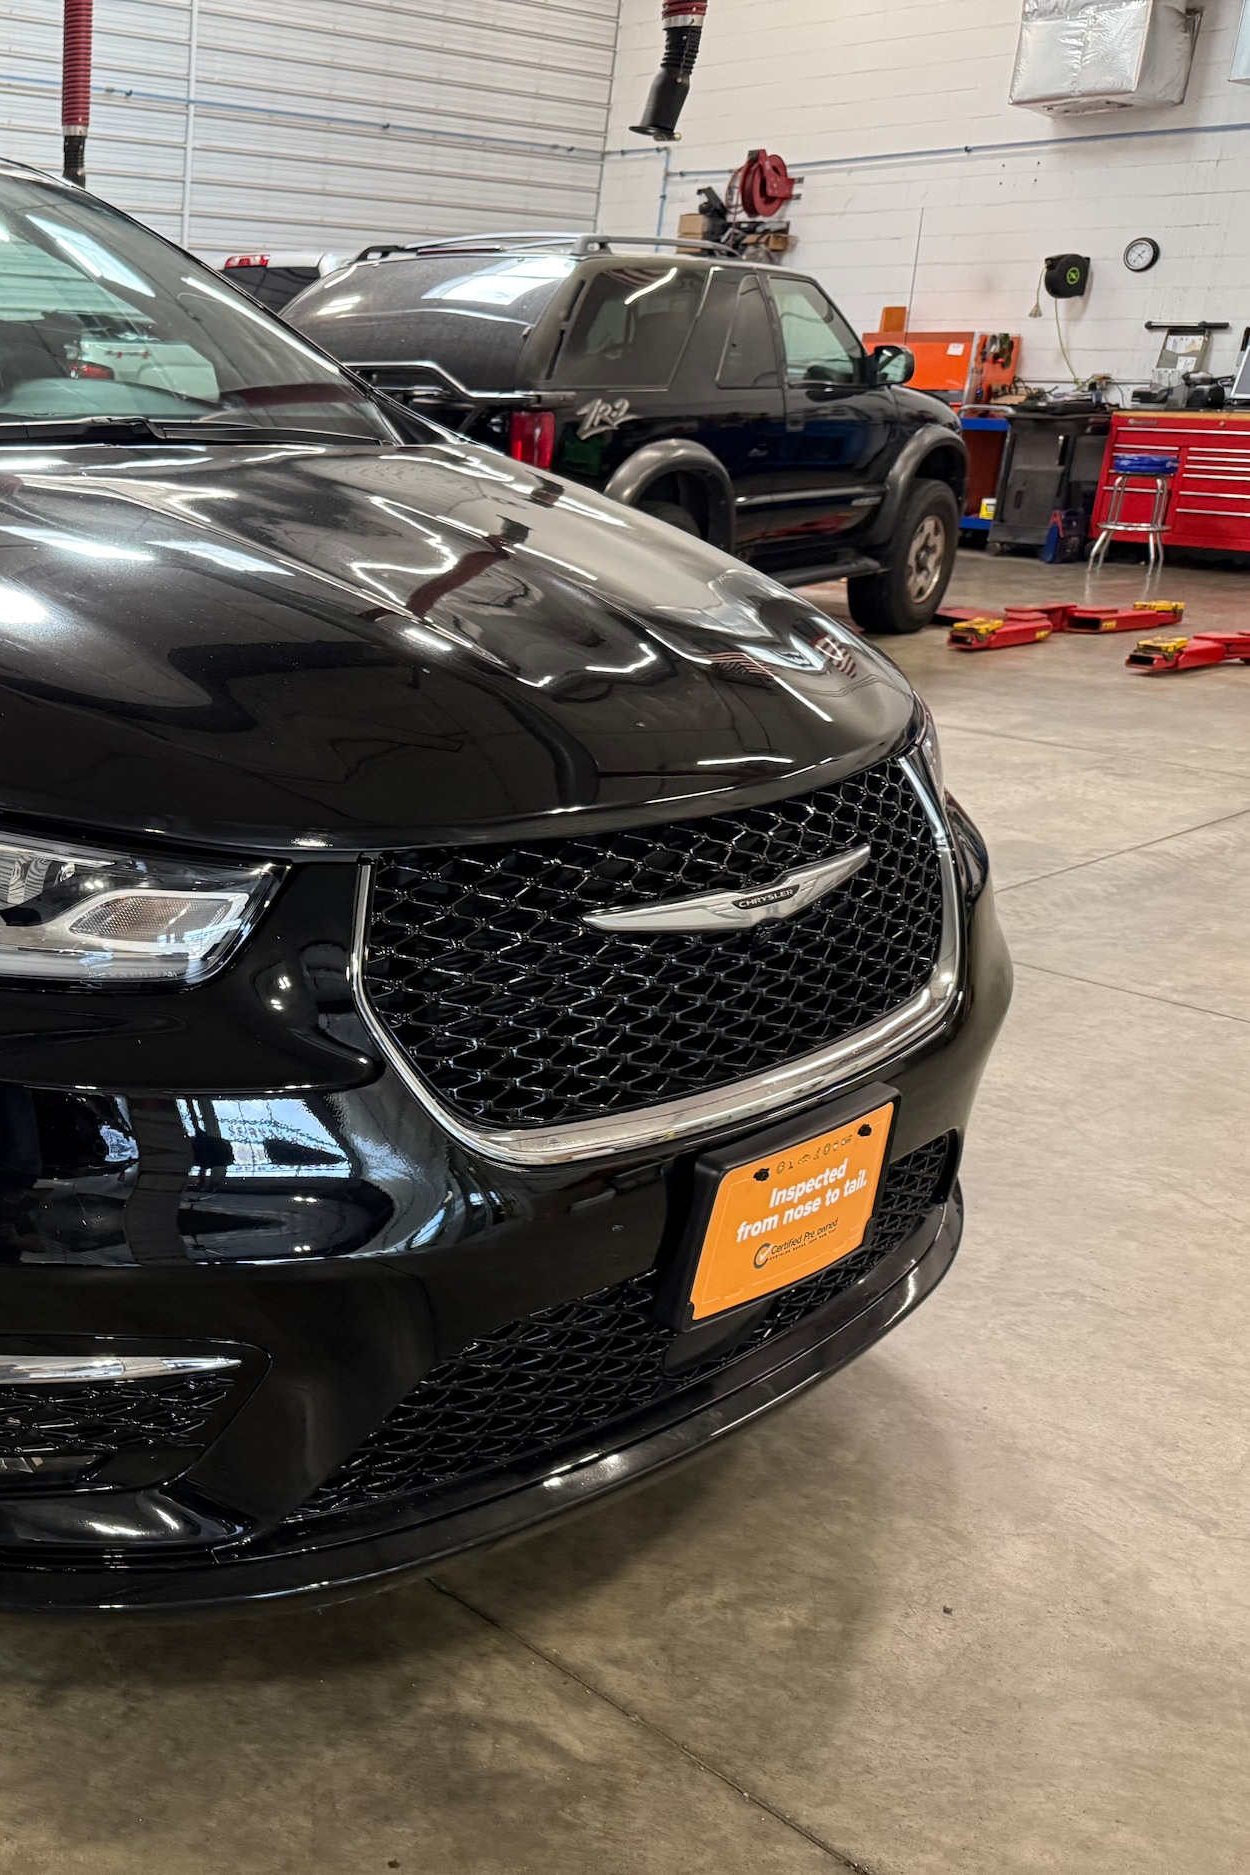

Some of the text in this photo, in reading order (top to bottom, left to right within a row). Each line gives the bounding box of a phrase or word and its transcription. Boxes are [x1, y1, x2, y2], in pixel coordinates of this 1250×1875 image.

[576, 398, 642, 440] ZR2
[738, 889, 794, 908] CHRYSLER
[768, 1157, 848, 1208] Inspected
[736, 1169, 867, 1243] from nose to tail.
[771, 1233, 803, 1255] Certified
